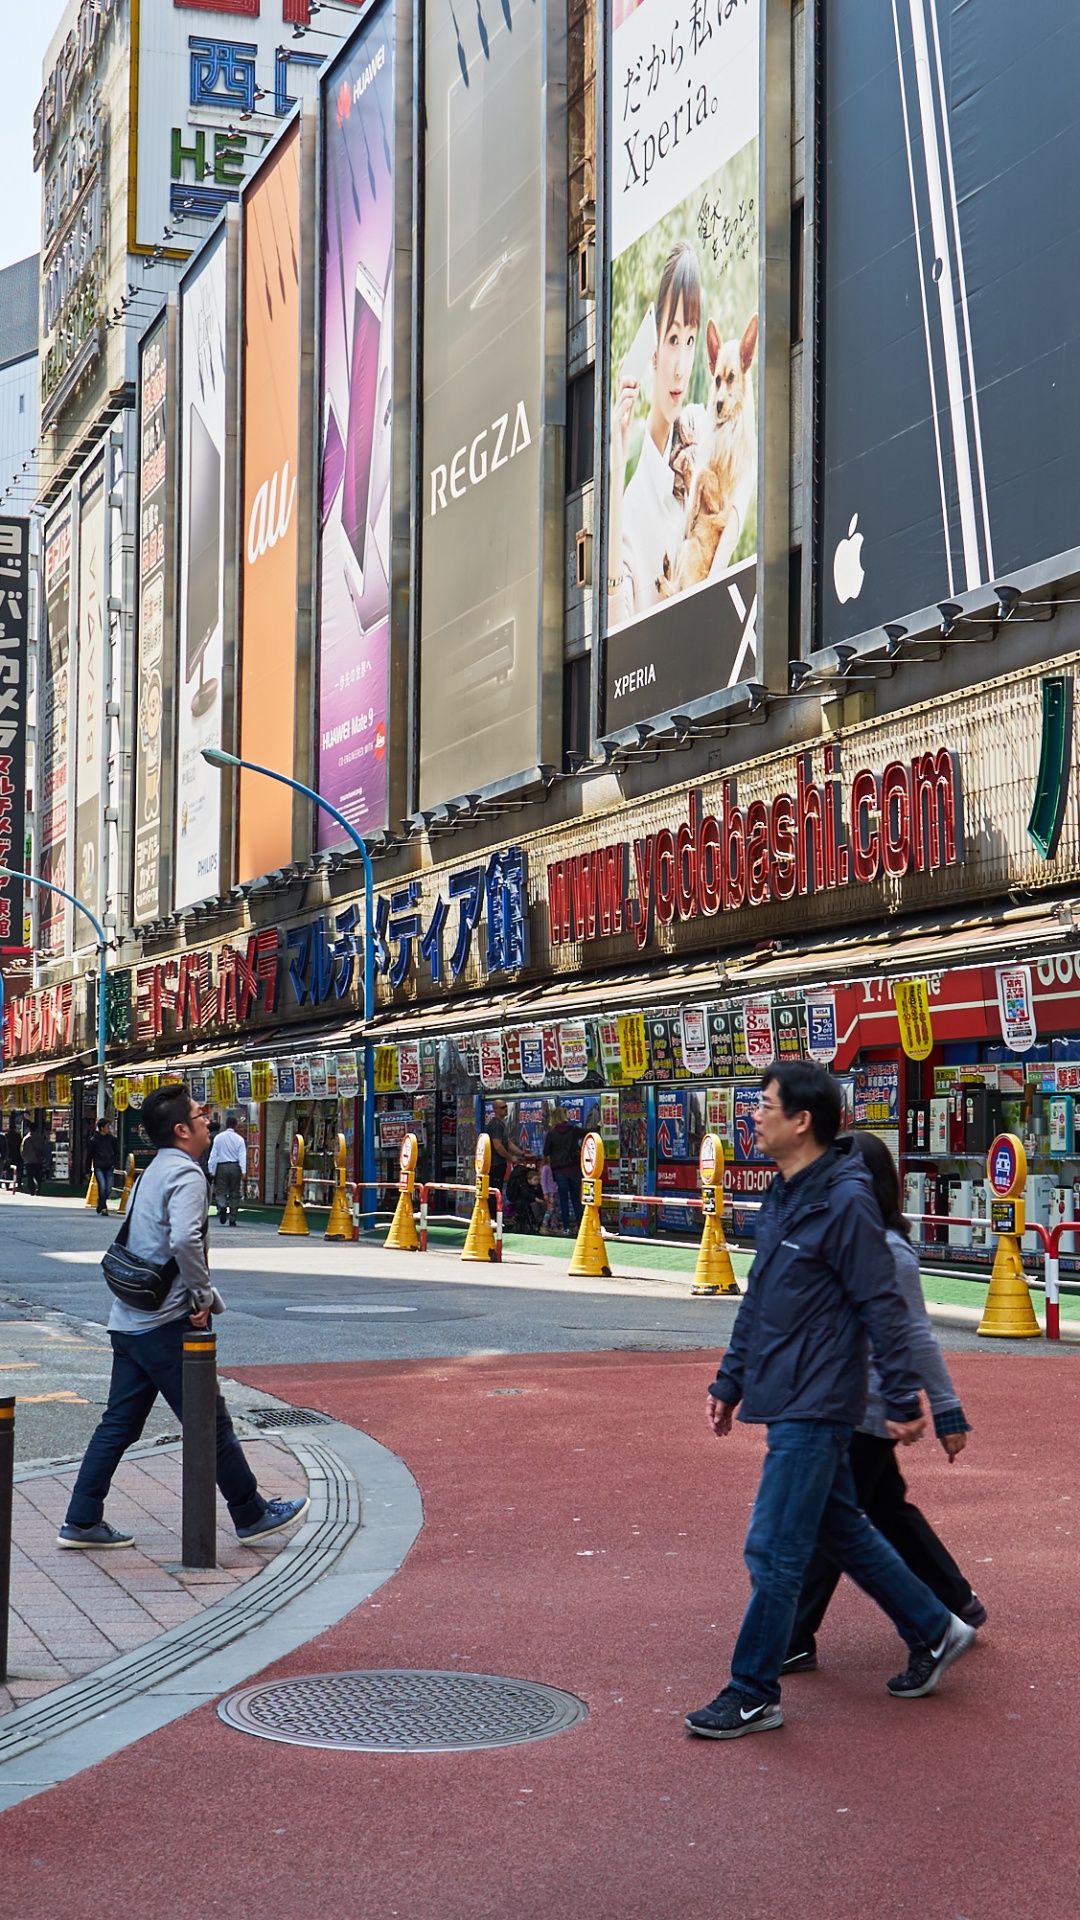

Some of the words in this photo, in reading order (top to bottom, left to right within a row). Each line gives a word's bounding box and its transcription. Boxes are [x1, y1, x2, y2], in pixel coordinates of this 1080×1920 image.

[353, 44, 385, 104] HUAWEI
[430, 400, 531, 516] REGZA
[248, 459, 297, 565] au
[614, 663, 656, 699] XPERIA
[322, 719, 351, 752] HUAWEI
[351, 713, 368, 736] Mate
[368, 706, 374, 728] 9
[197, 852, 218, 878] PHILIPS
[547, 744, 962, 951] www.yodobashi.com
[137, 929, 280, 1040] ヨドバシカメラ
[746, 1015, 769, 1030] 8%
[812, 1018, 833, 1034] 5%
[400, 1052, 417, 1064] 8%
[481, 1047, 500, 1058] 8%
[749, 1037, 770, 1054] 5%
